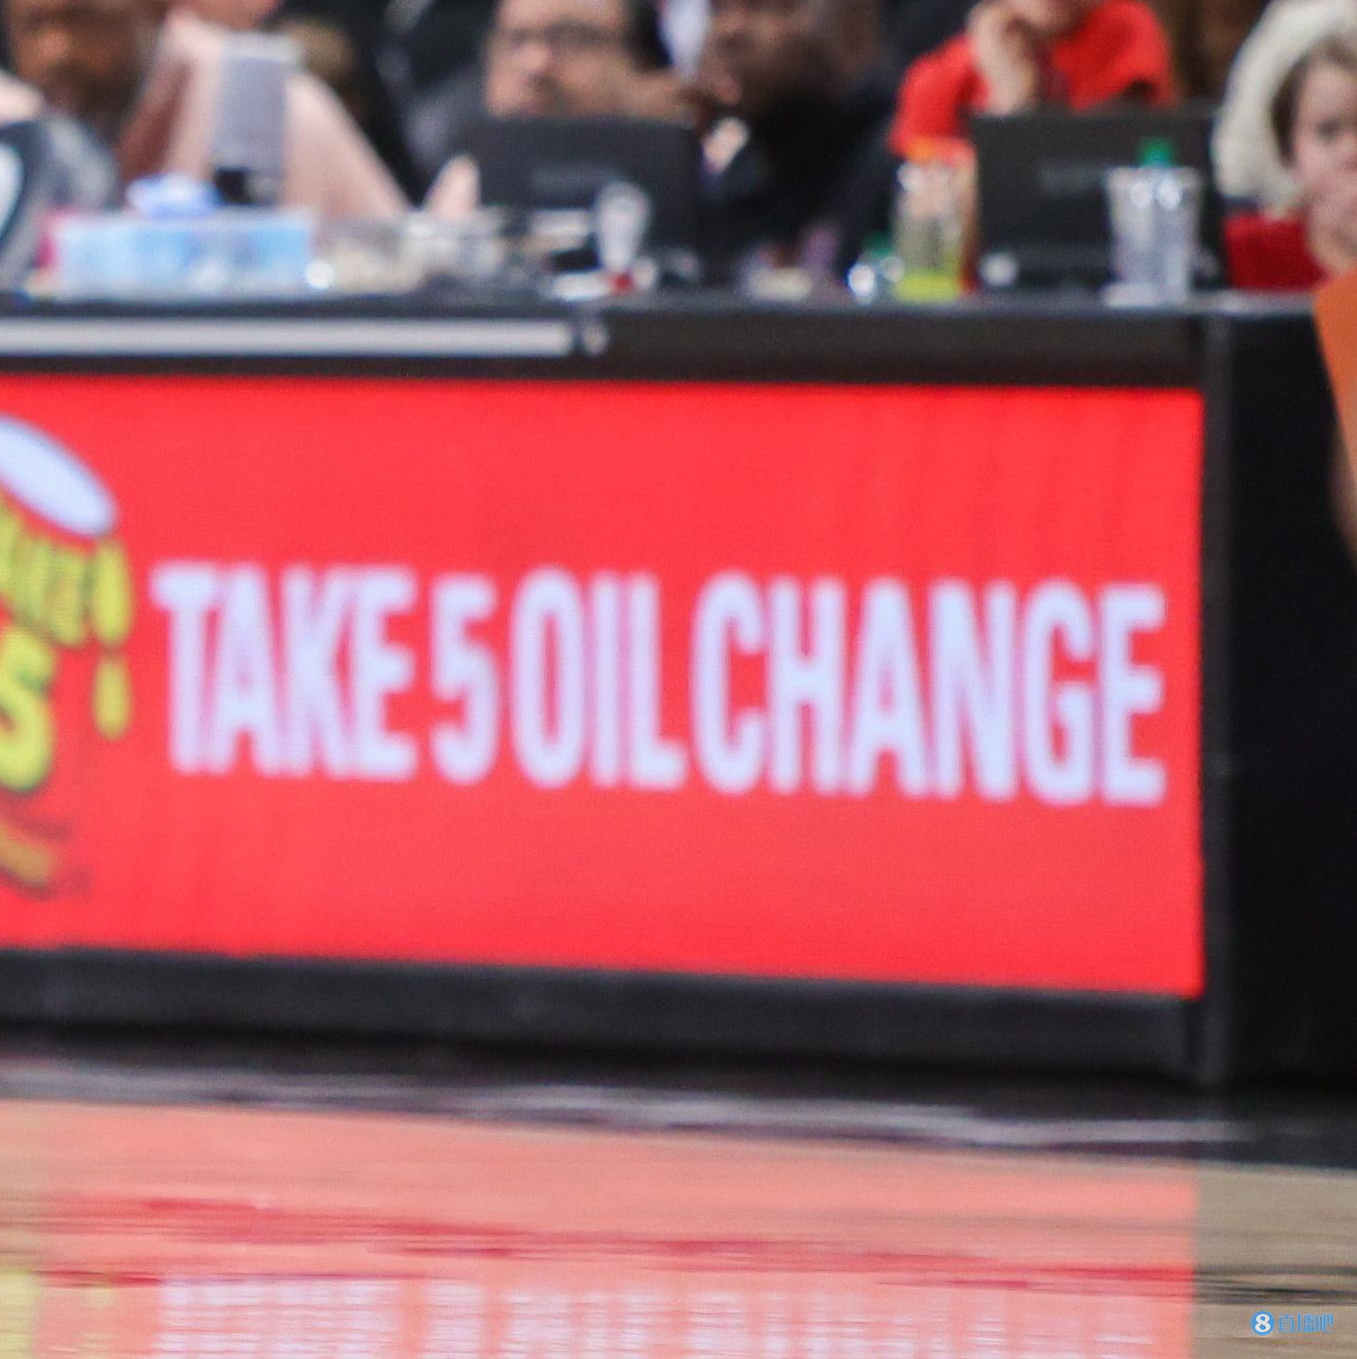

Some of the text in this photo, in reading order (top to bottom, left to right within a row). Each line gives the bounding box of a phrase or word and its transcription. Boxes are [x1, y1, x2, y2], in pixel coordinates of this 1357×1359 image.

[150, 562, 1168, 807] TAKE 5 OIL CHANGE
